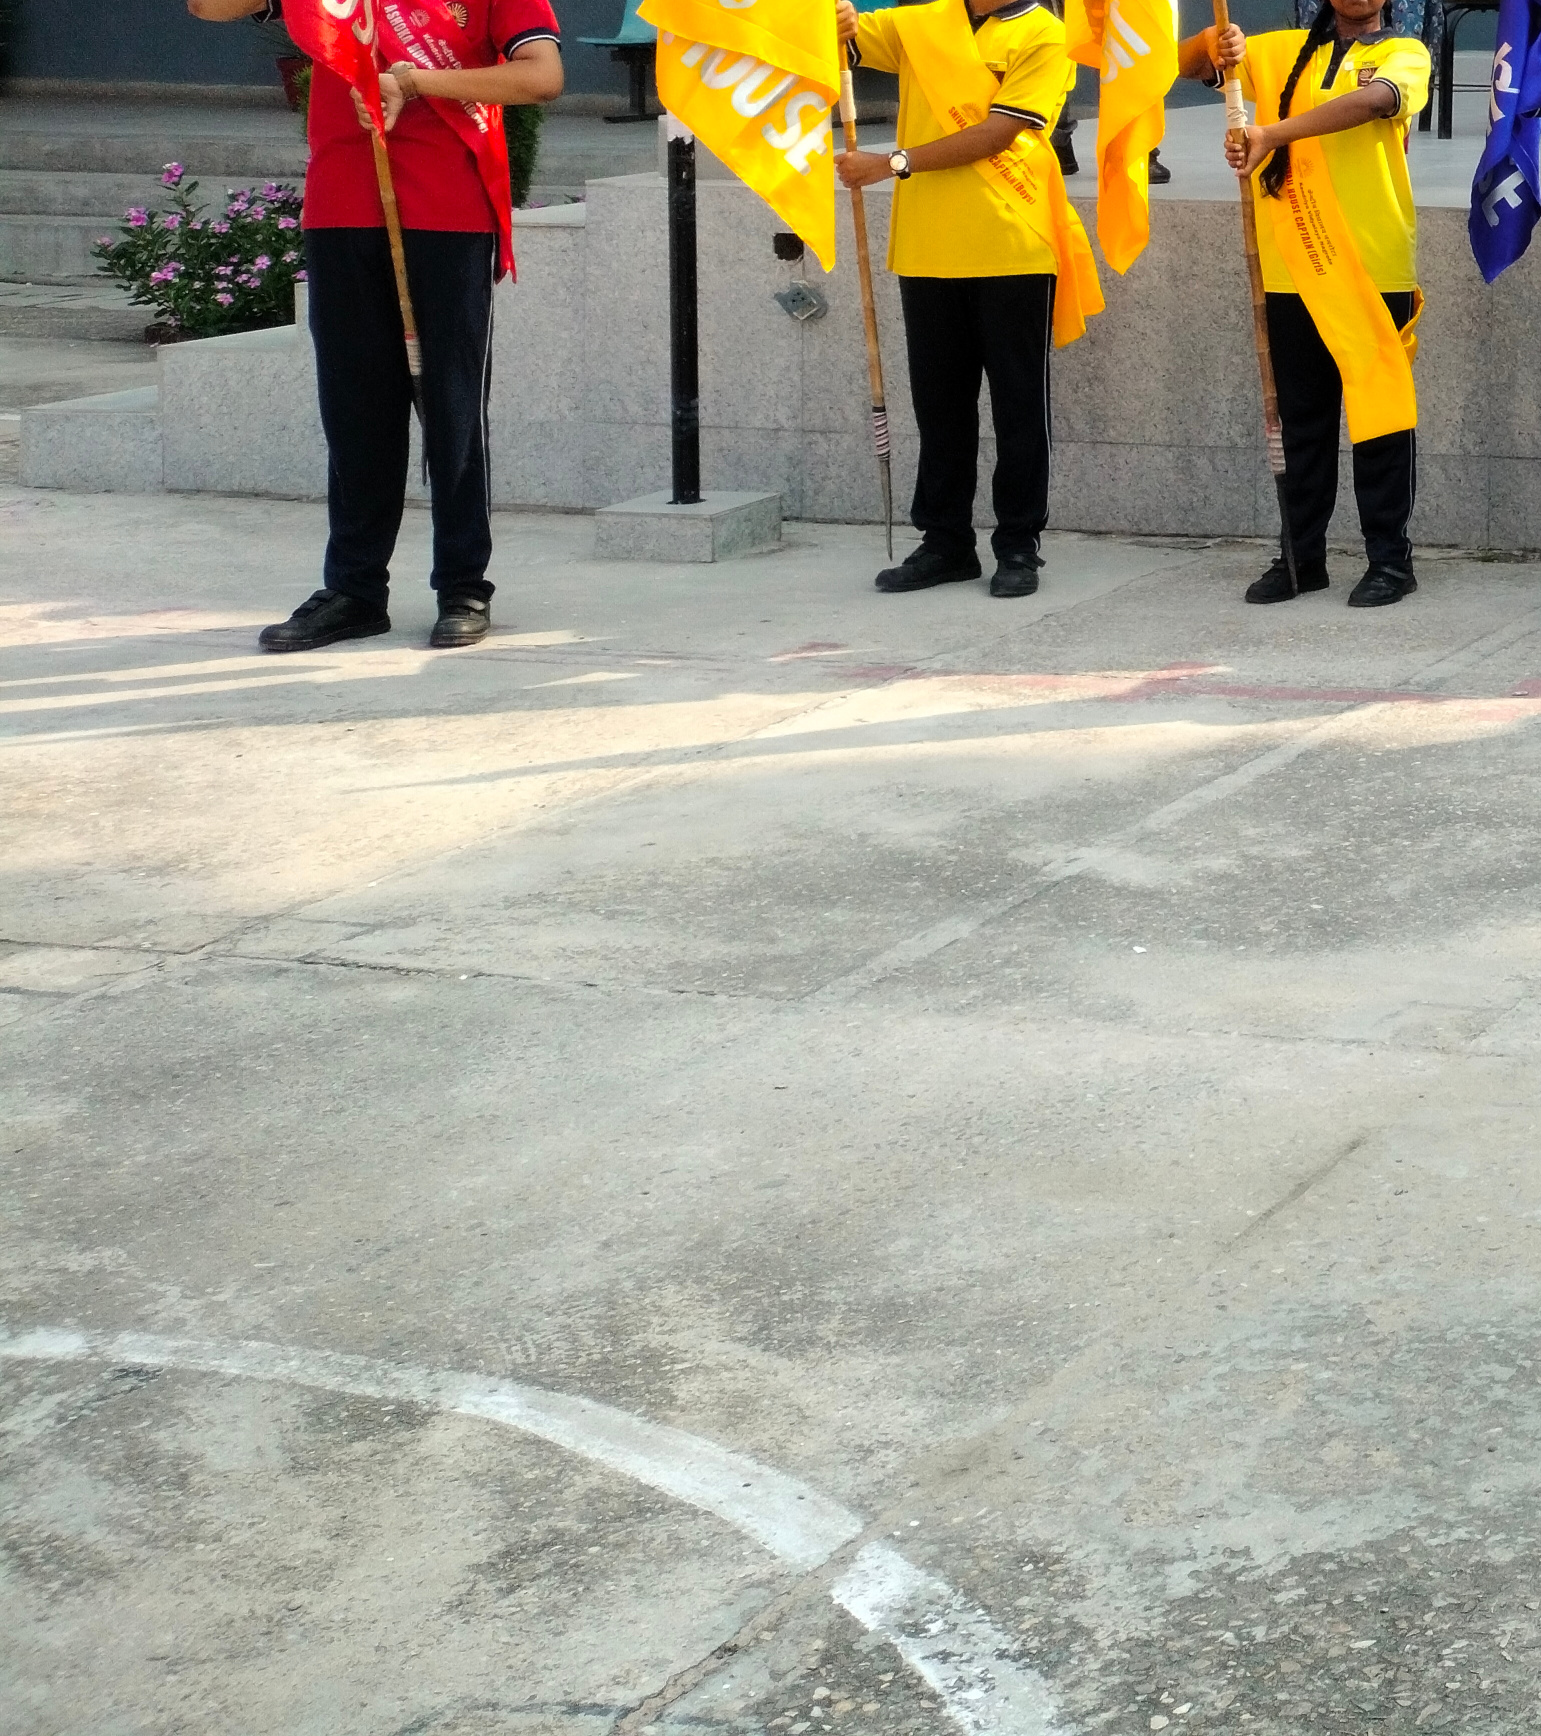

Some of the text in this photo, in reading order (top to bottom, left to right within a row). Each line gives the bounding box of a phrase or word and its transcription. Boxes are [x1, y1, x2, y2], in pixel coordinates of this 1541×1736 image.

[384, 4, 415, 44] ASHOKA
[988, 155, 1019, 186] CAPTAIN
[1287, 188, 1327, 276] HOUSE CAPTAIN (Girls)
